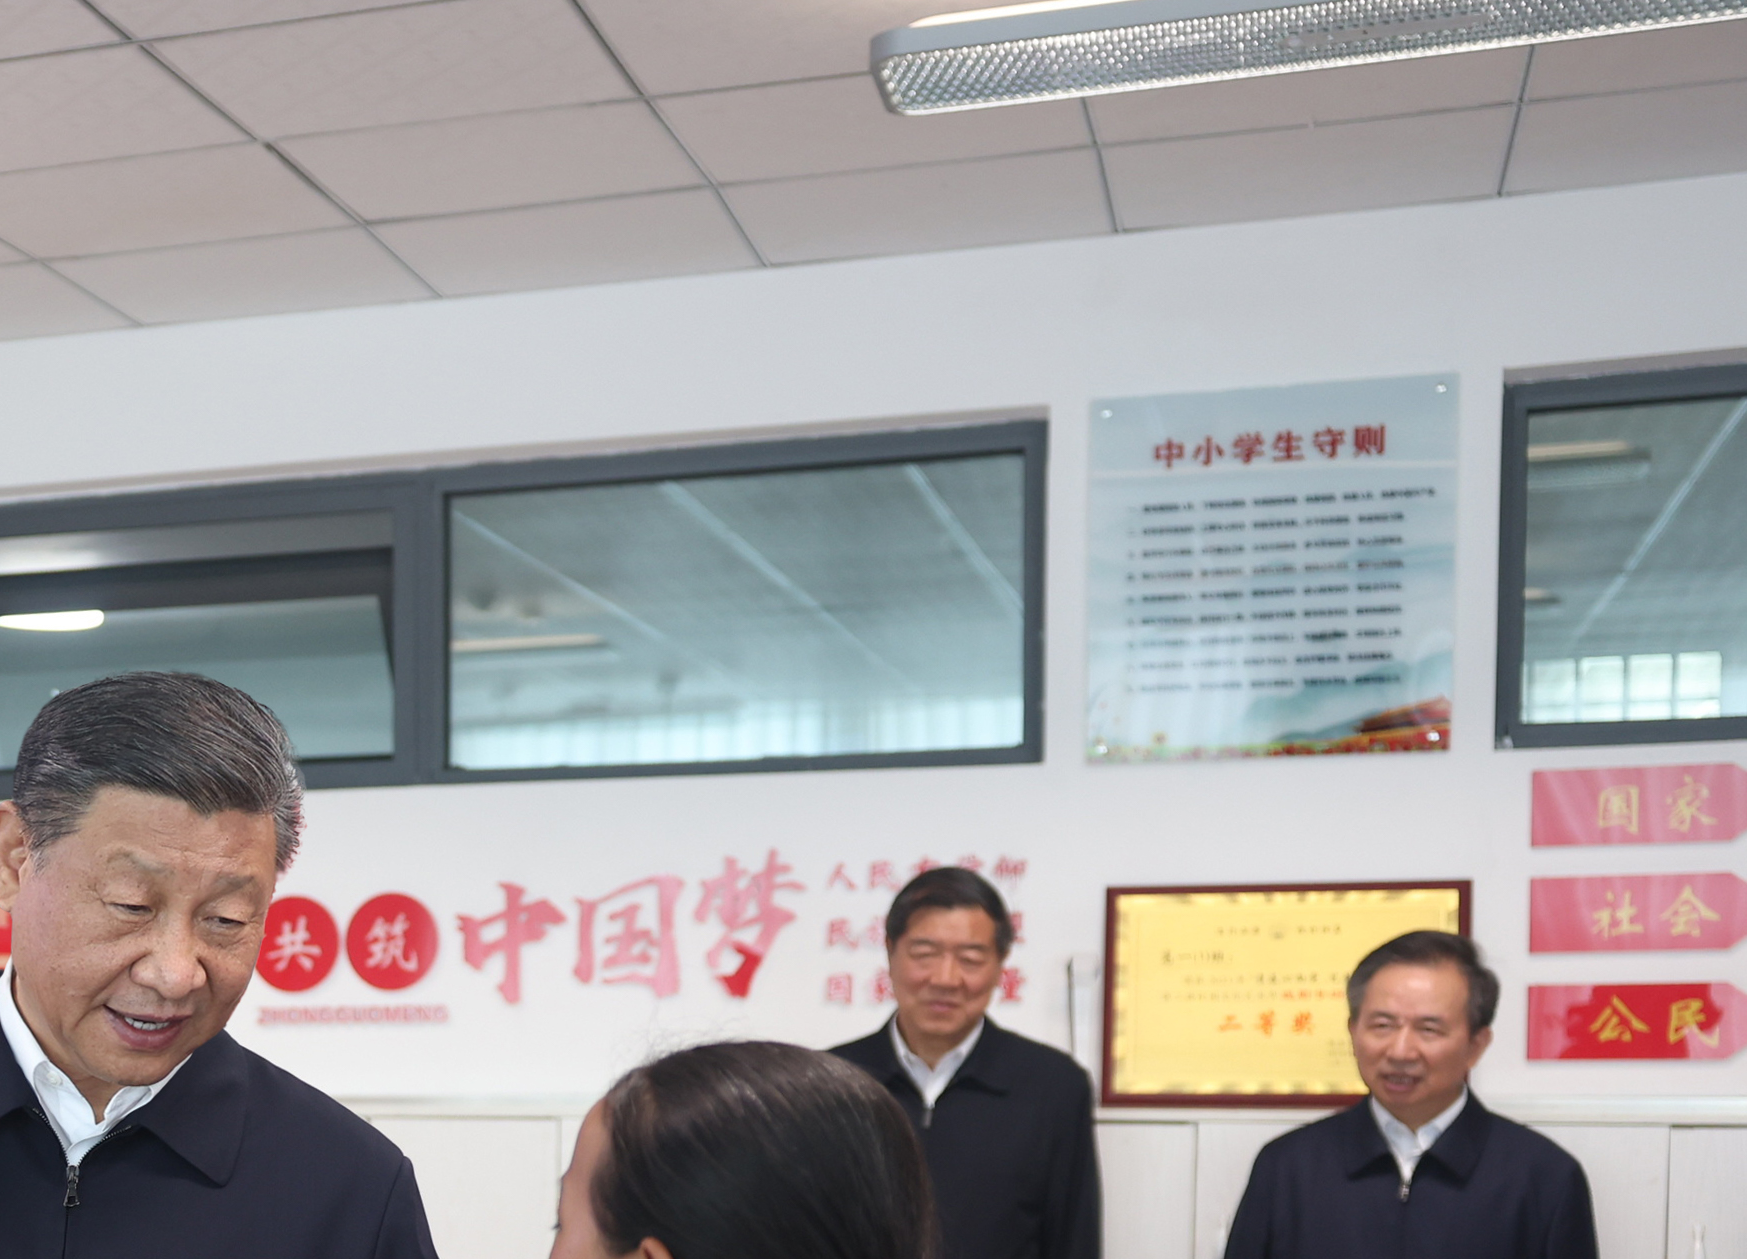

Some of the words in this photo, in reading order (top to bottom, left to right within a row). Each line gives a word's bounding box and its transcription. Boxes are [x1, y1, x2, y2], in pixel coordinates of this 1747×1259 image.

[1153, 424, 1386, 469] 中小学生守则
[1597, 774, 1718, 835] 国家
[267, 913, 418, 972] 共筑
[455, 848, 806, 1004] 中国梦
[1591, 884, 1721, 940] 社会
[1589, 994, 1720, 1048] 公民
